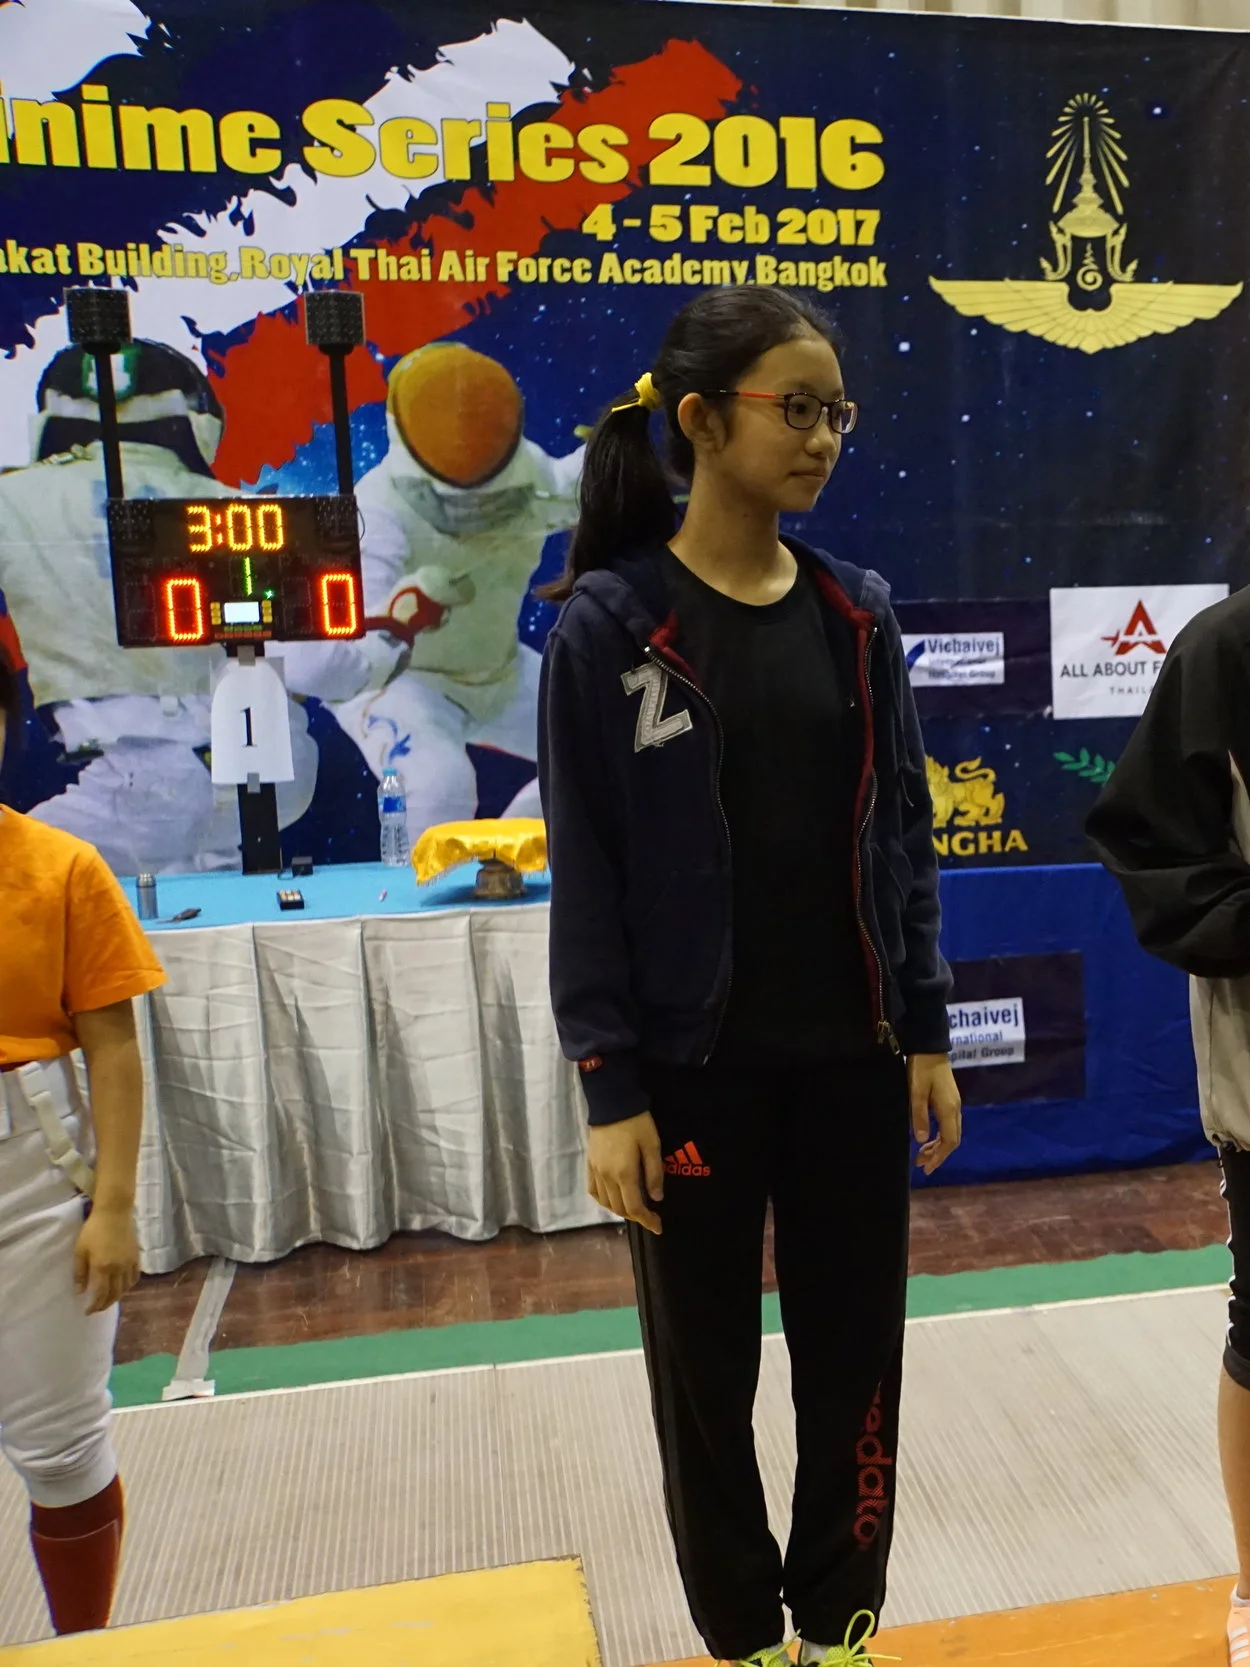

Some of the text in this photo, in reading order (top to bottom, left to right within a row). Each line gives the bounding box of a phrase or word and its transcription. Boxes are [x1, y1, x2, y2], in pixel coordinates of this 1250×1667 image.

[302, 99, 630, 184] Series
[648, 113, 885, 190] 2016
[690, 205, 770, 243] Feb
[777, 208, 880, 245] 2017
[350, 248, 431, 281] Thai
[438, 250, 489, 282] Air
[496, 251, 591, 283] Force
[187, 503, 284, 552] 3:00
[166, 579, 203, 642] 0
[321, 574, 357, 635] 0
[928, 637, 1000, 656] Vichaivej
[1060, 664, 1087, 678] ALL
[1094, 661, 1147, 677] ABOUT
[240, 707, 255, 747] 1
[621, 661, 693, 753] Z
[981, 1047, 1014, 1058] Group
